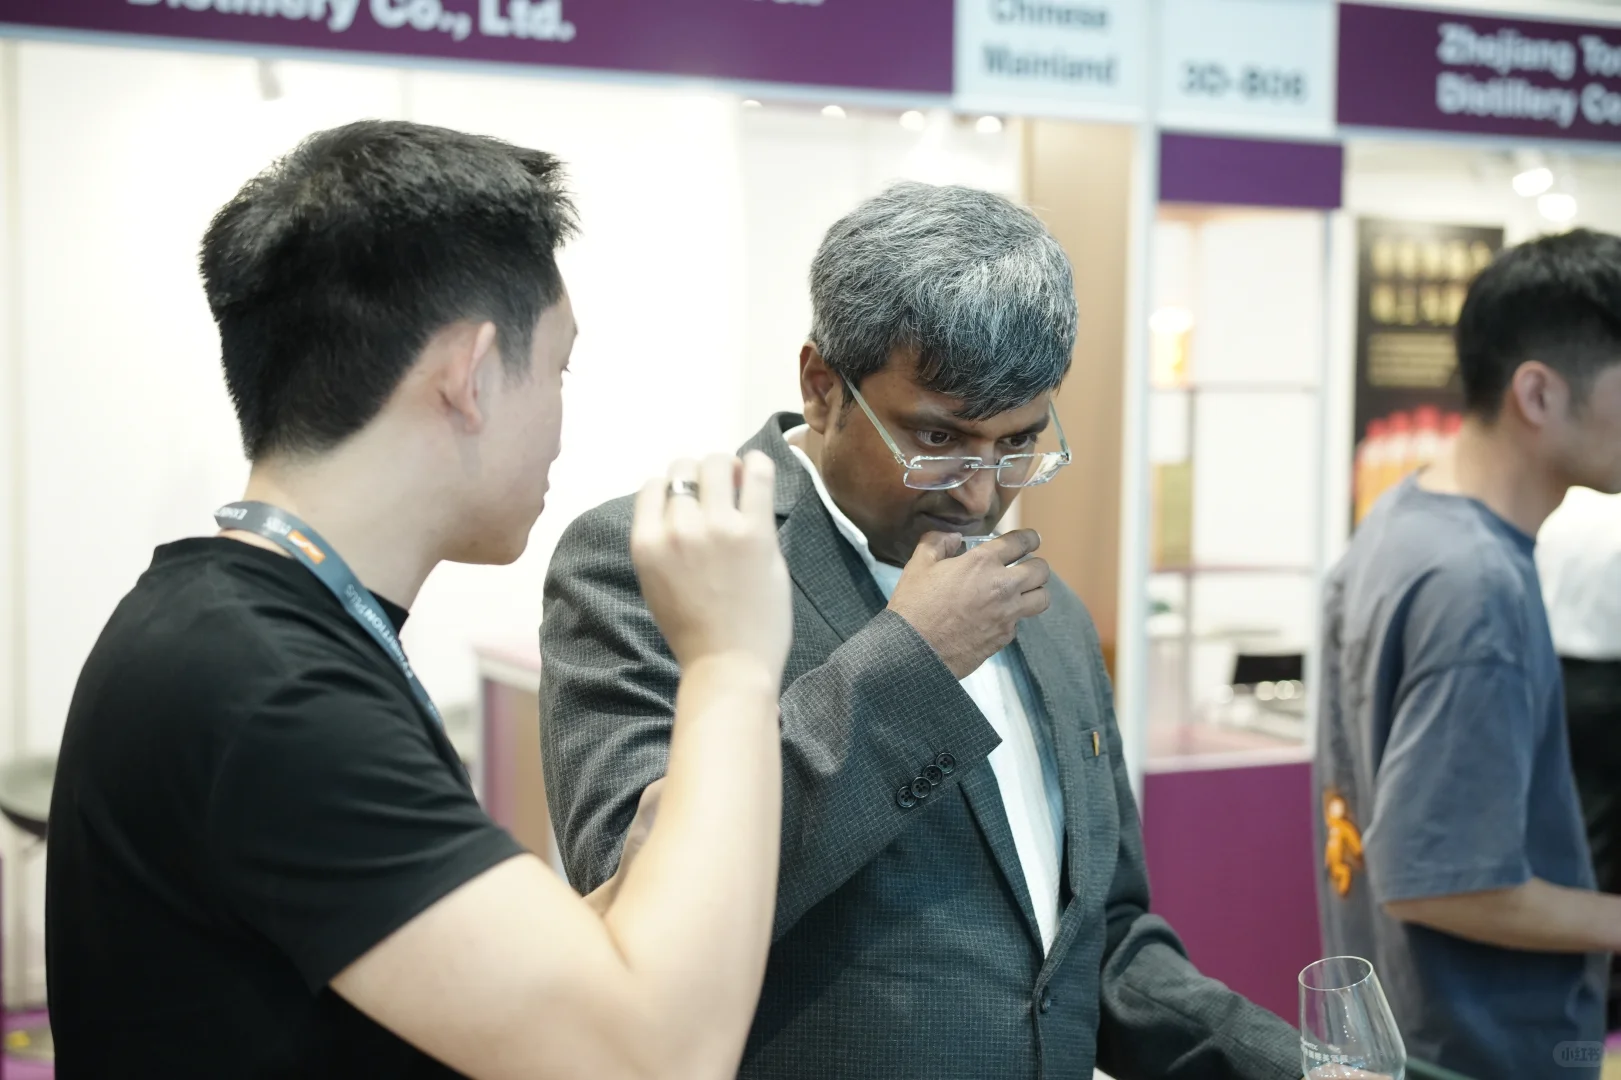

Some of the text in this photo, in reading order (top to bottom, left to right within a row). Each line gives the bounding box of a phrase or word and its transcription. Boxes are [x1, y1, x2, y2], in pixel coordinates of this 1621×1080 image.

[983, 44, 1117, 86] Mainland
[1437, 22, 1575, 80] Zhejiang
[1436, 71, 1577, 127] Distillery
